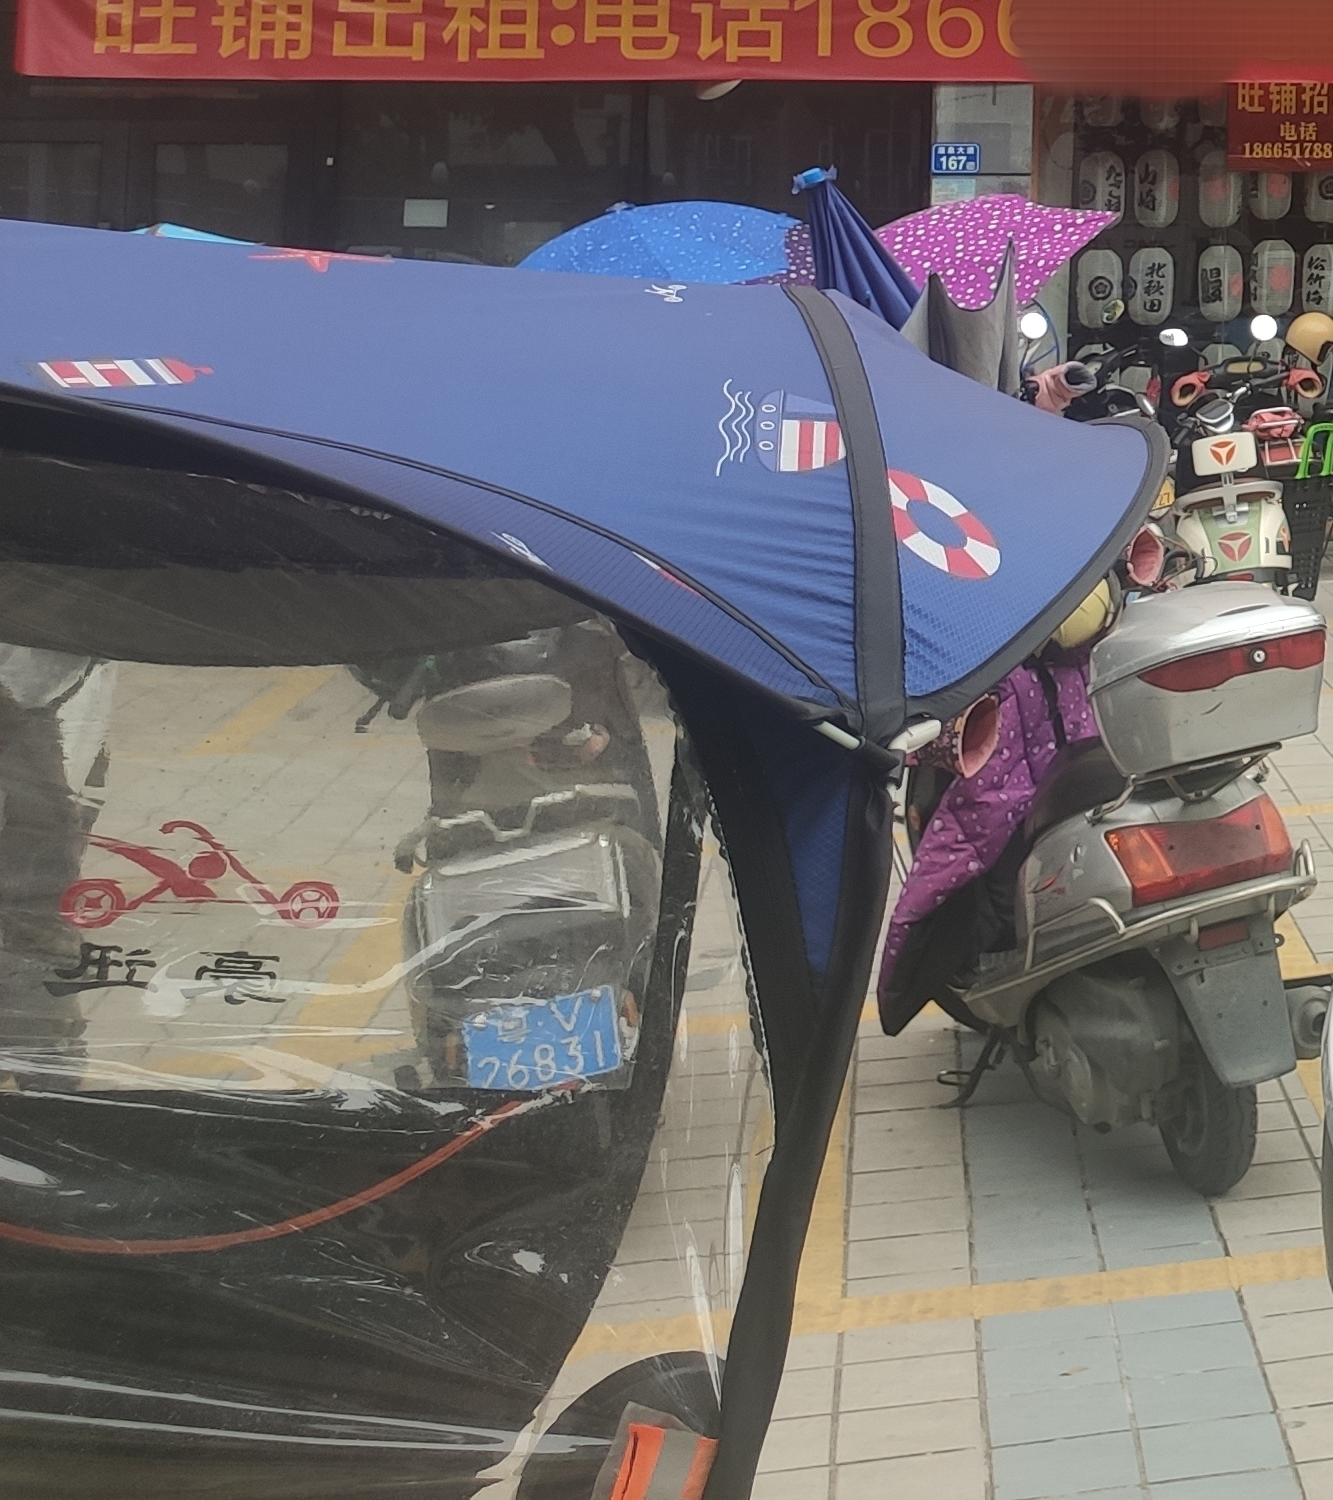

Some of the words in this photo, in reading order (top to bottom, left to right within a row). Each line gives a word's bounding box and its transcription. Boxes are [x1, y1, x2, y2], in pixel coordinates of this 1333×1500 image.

[1279, 122, 1318, 141] 电话
[939, 155, 967, 171] 167
[1142, 262, 1167, 313] 北秋田
